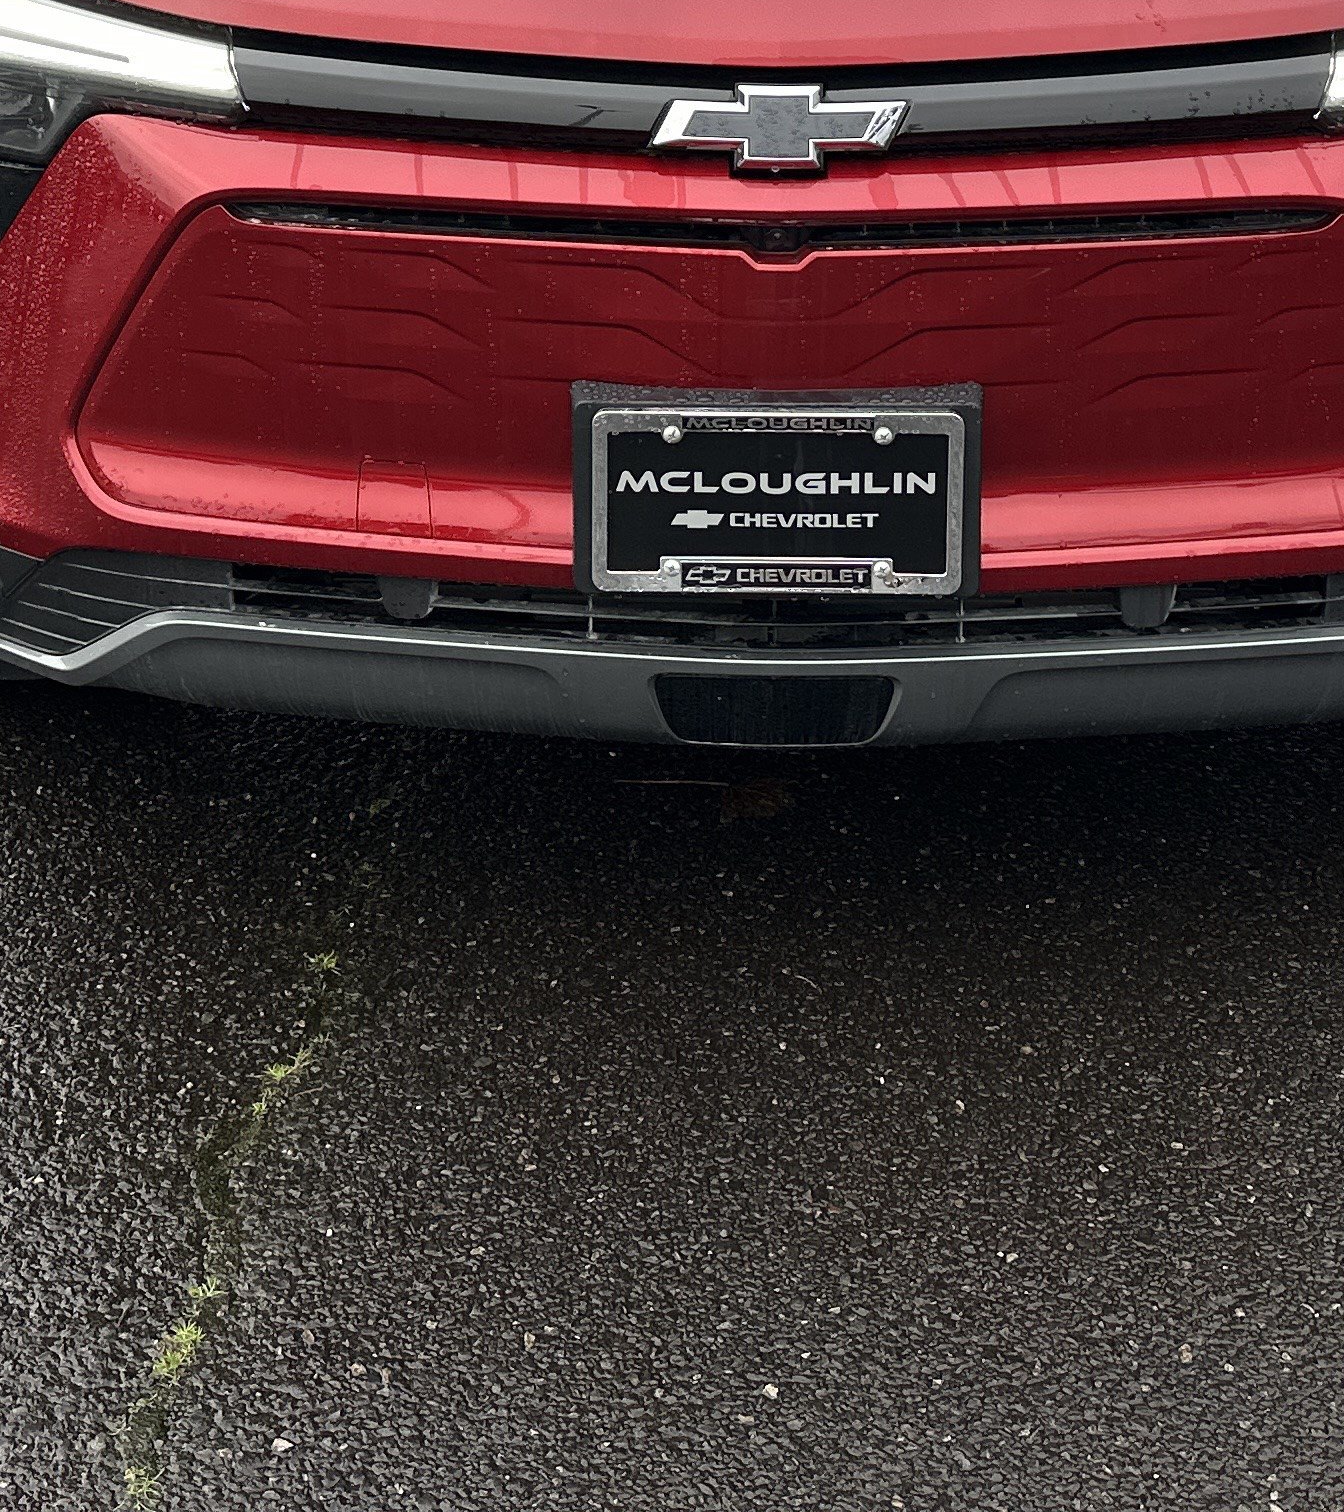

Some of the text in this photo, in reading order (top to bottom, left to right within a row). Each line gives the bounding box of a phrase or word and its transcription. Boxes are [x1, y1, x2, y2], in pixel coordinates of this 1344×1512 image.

[686, 416, 873, 431] MCLOUGHLIN
[615, 470, 936, 495] MCLOUGHLIN
[729, 512, 880, 529] CHEVROLET
[736, 568, 871, 584] CHEVROLET
